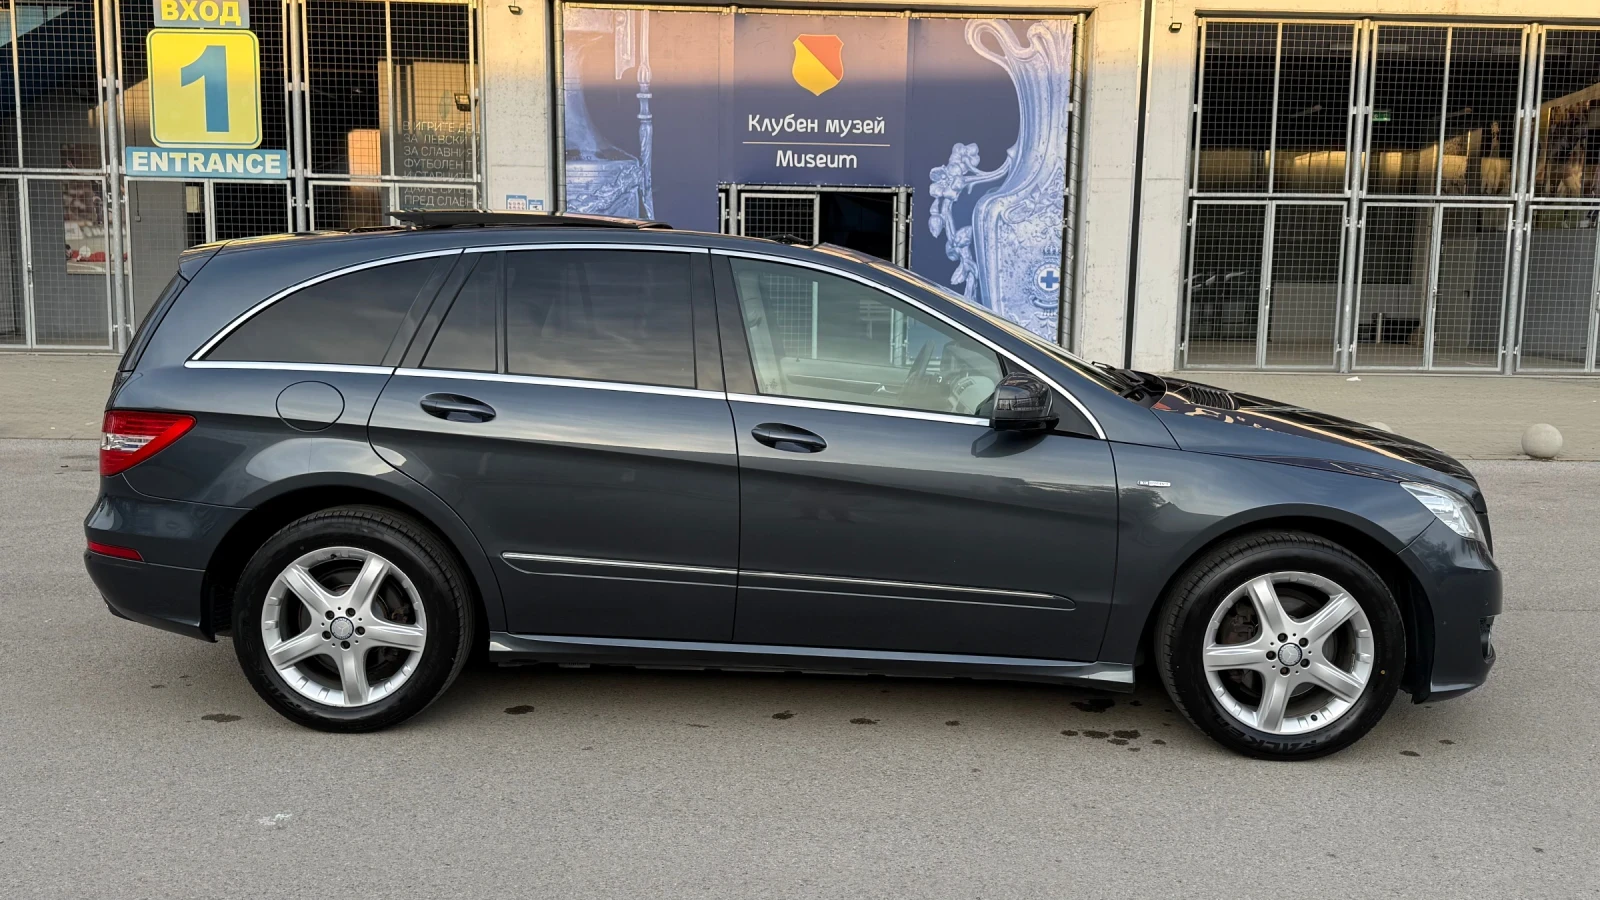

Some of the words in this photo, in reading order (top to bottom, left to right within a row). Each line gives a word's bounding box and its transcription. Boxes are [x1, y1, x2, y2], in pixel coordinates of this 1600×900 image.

[161, 0, 242, 27] ВХОД
[181, 45, 230, 133] 1
[403, 121, 410, 131] В
[414, 121, 456, 132] ИГРИТЕ
[748, 113, 819, 137] Клубен
[825, 116, 886, 138] музей
[403, 133, 418, 144] ЗА
[424, 134, 468, 146] ЛЕВСКИ
[403, 145, 419, 156] ЗА
[421, 146, 473, 158] СЛАВНИЯ
[776, 150, 858, 169] Museum
[132, 151, 281, 174] ENTRANCE
[403, 158, 464, 170] ФУТБОЛЕН
[404, 195, 435, 207] ПРЕД
